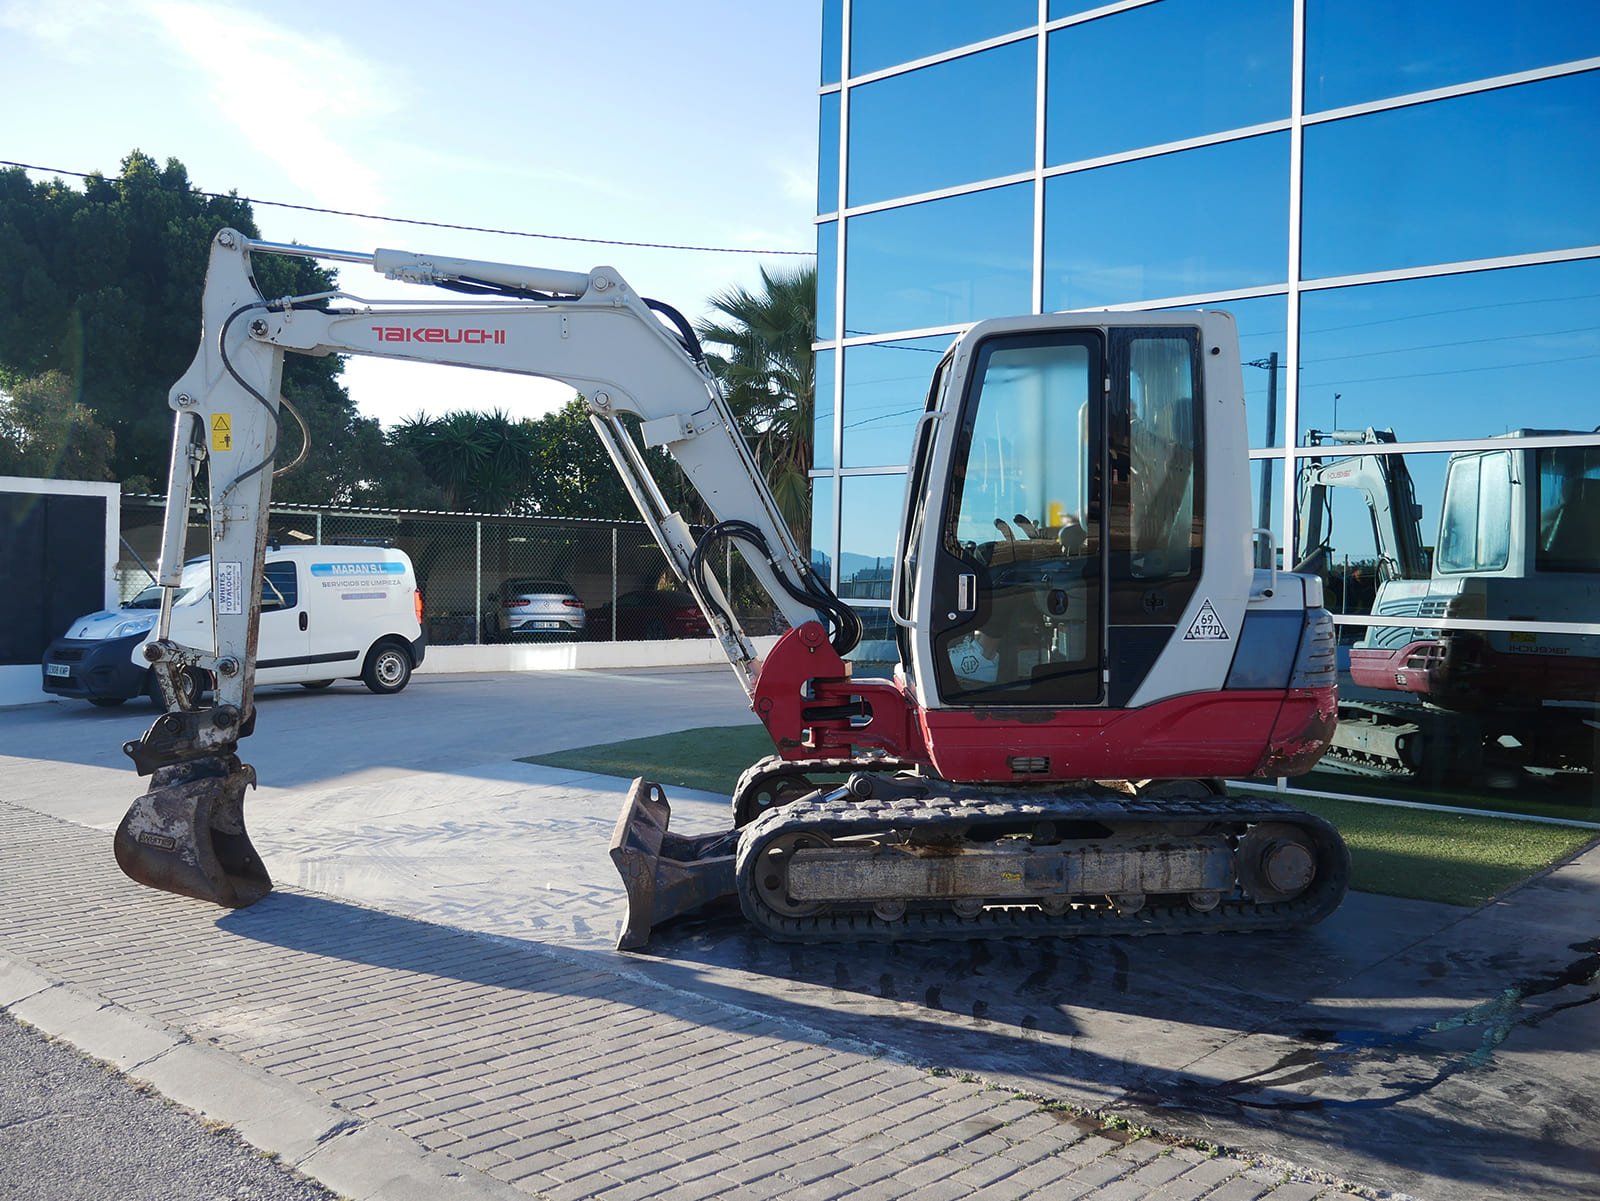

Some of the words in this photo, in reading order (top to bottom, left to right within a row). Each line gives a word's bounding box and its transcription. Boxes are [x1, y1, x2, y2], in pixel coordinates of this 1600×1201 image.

[371, 326, 505, 345] TAKEUCHI
[331, 564, 370, 575] MARAN
[321, 580, 360, 588] SERVICIOS
[370, 579, 401, 587] LIMPIEZA
[1201, 614, 1214, 625] 69
[1194, 625, 1220, 636] AT7D
